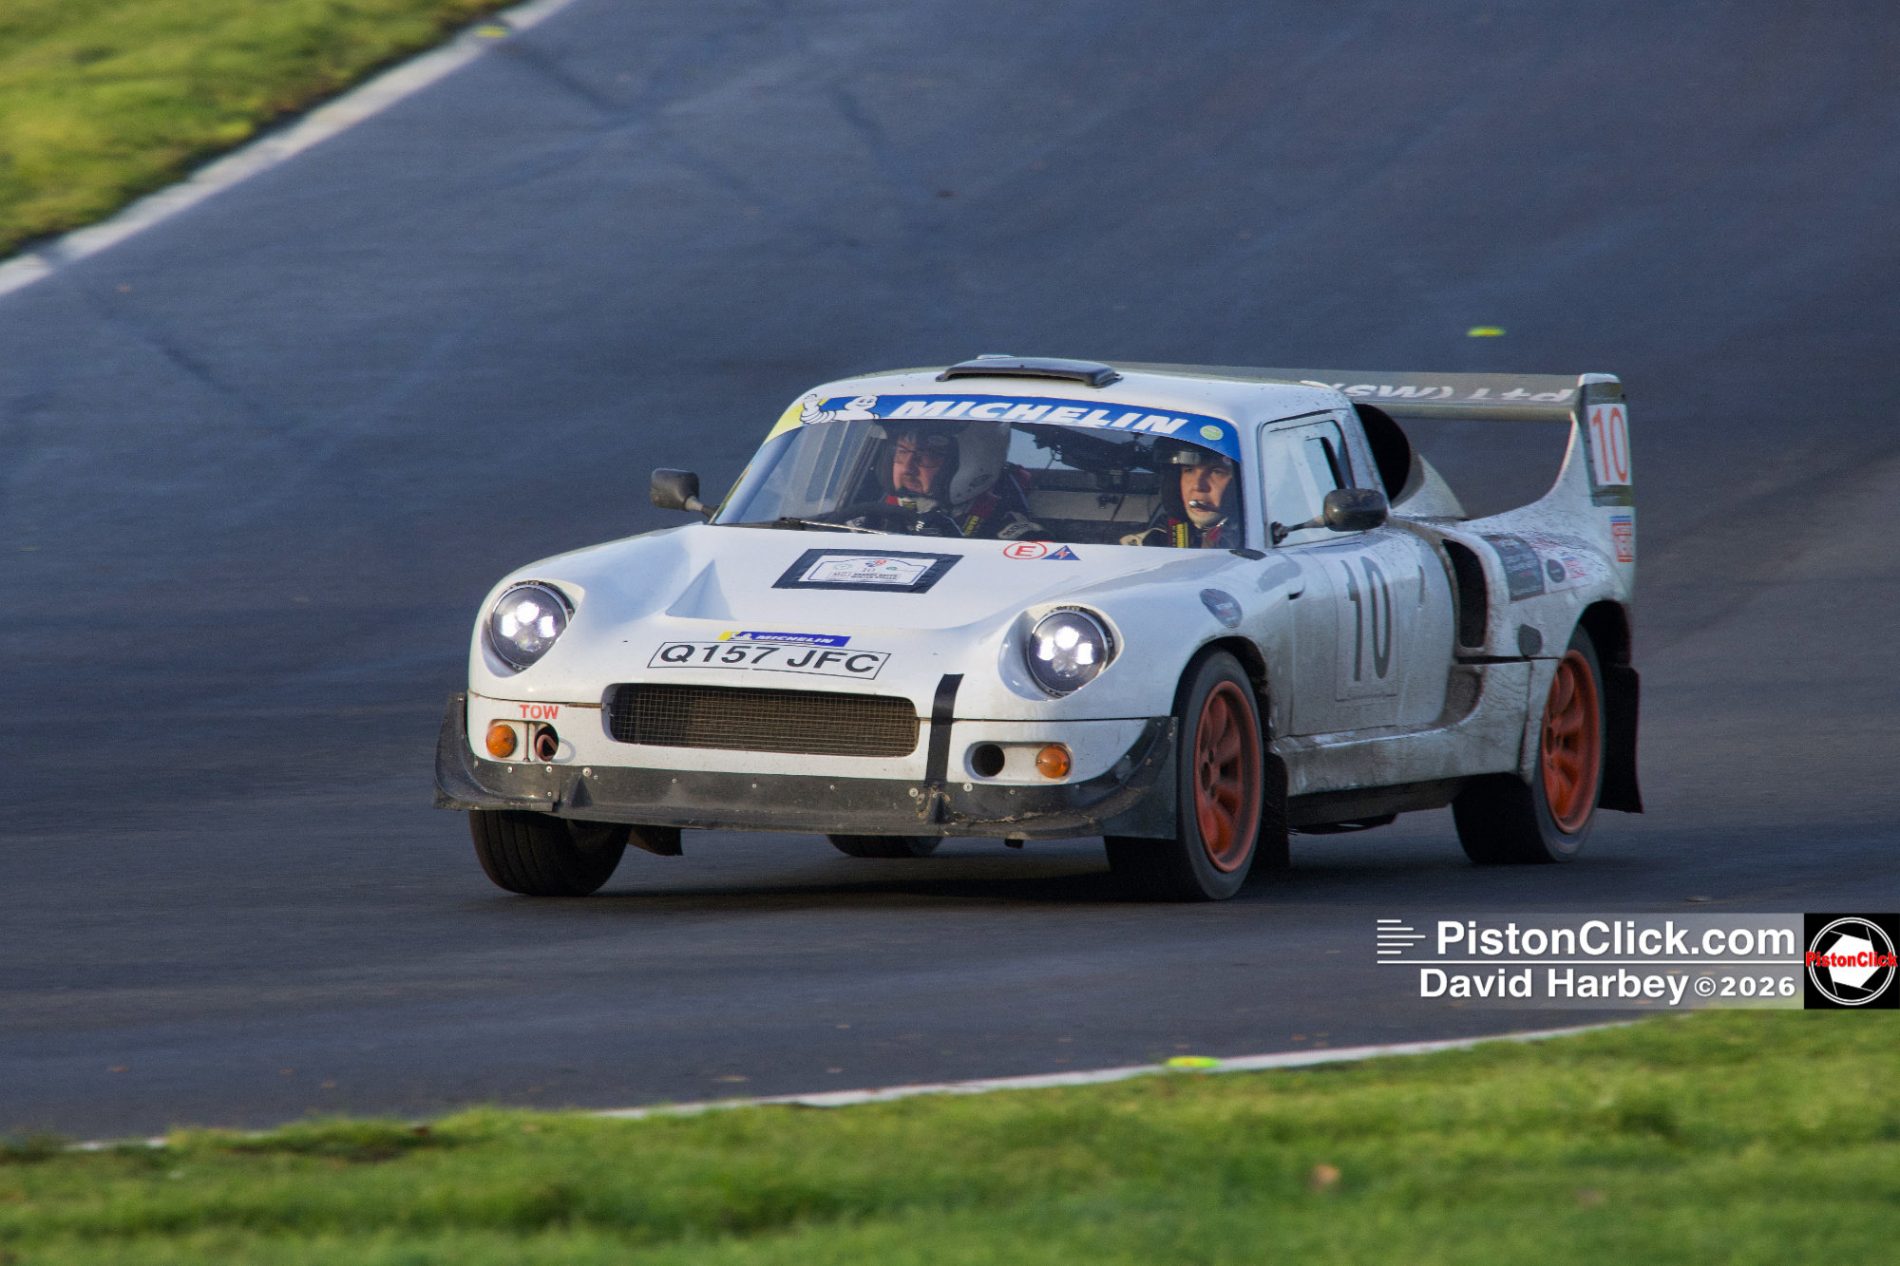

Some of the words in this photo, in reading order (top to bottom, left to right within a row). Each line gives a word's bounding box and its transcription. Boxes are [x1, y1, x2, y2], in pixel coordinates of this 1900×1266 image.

[1466, 387, 1575, 402] Ltd
[889, 401, 1189, 435] MICHELIN
[1592, 407, 1628, 483] 10
[1340, 556, 1392, 682] 10
[755, 635, 836, 645] MICHELIN
[660, 644, 780, 665] Q157
[786, 649, 880, 673] JFC
[519, 703, 559, 719] TOW
